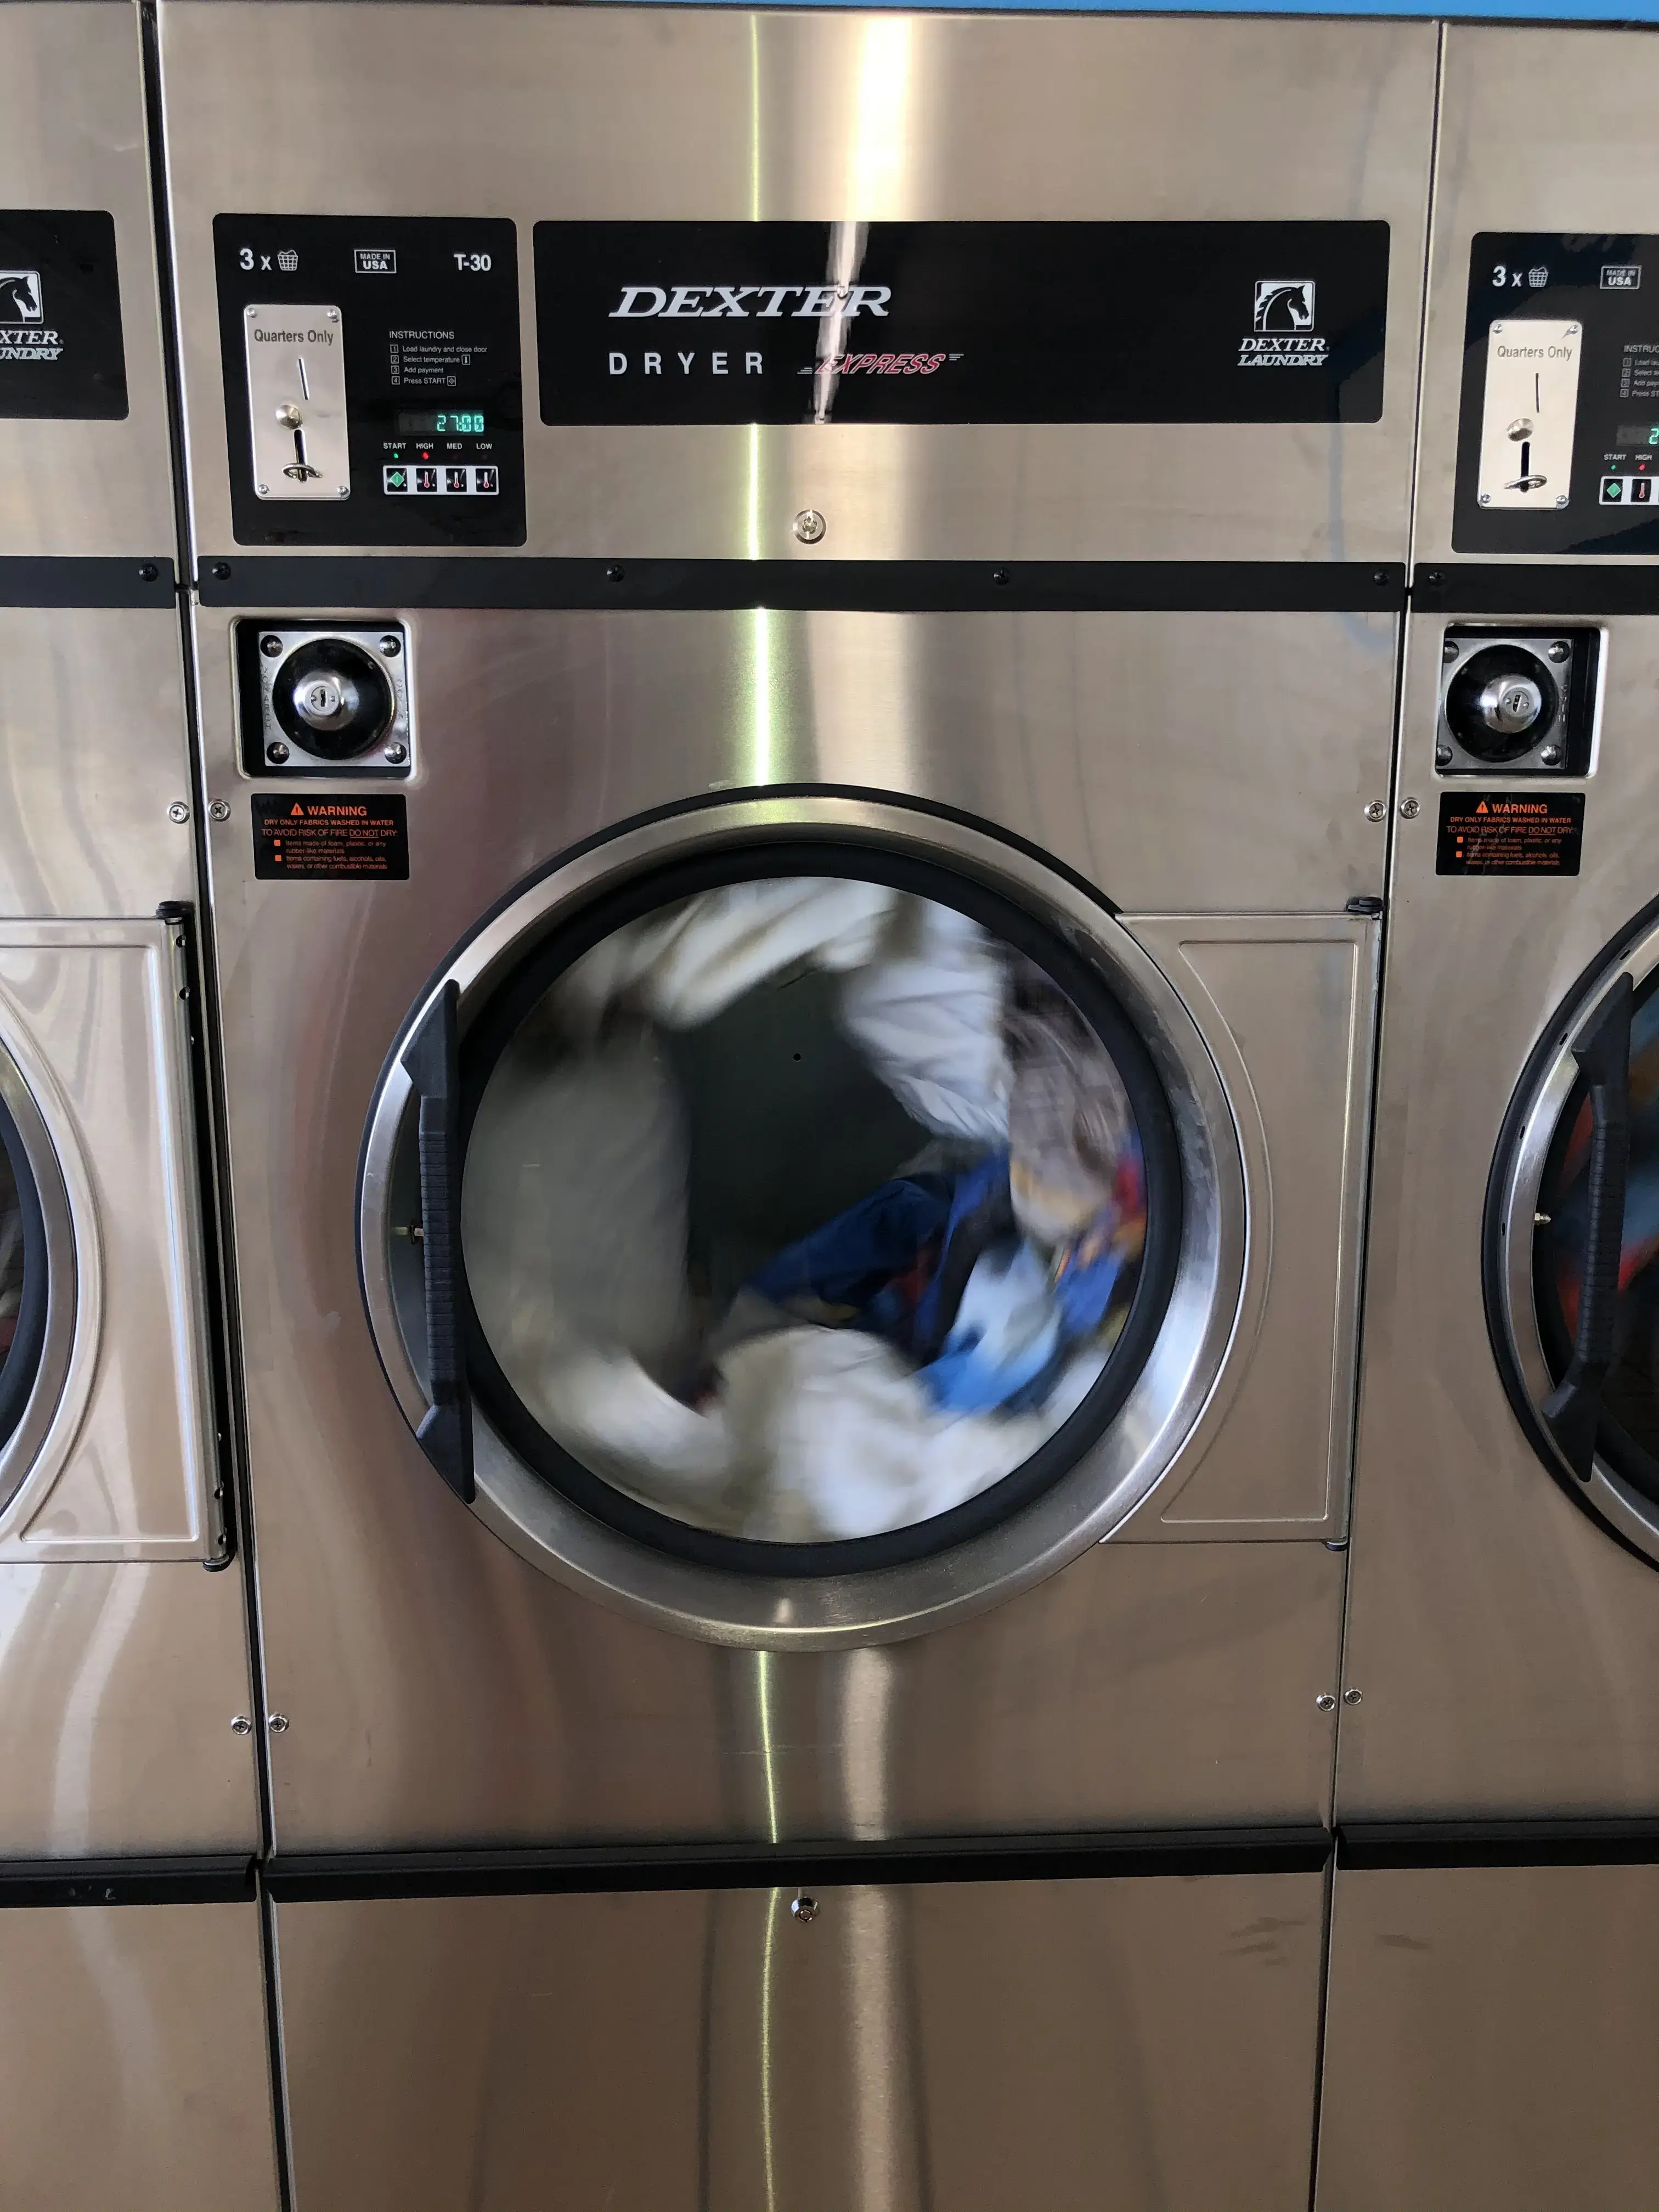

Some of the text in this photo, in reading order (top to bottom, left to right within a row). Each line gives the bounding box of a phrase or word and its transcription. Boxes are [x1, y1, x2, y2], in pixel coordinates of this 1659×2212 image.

[240, 249, 272, 270] 3 x
[363, 261, 388, 270] USA
[453, 254, 492, 271] T-30
[1492, 266, 1523, 287] 3 x
[1607, 276, 1632, 286] USA
[608, 286, 891, 317] DEXTER
[254, 330, 334, 346] Quarters Only
[389, 331, 455, 339] INSTRUCTIONS
[1238, 338, 1325, 351] DEXTER
[1237, 354, 1329, 366] LAUNDRY
[1497, 346, 1573, 361] Quarters Only
[609, 352, 946, 375] DRYER EXPRESS
[436, 415, 484, 432] 27:00
[307, 806, 367, 816] WARNING
[1492, 804, 1548, 814] WARNING
